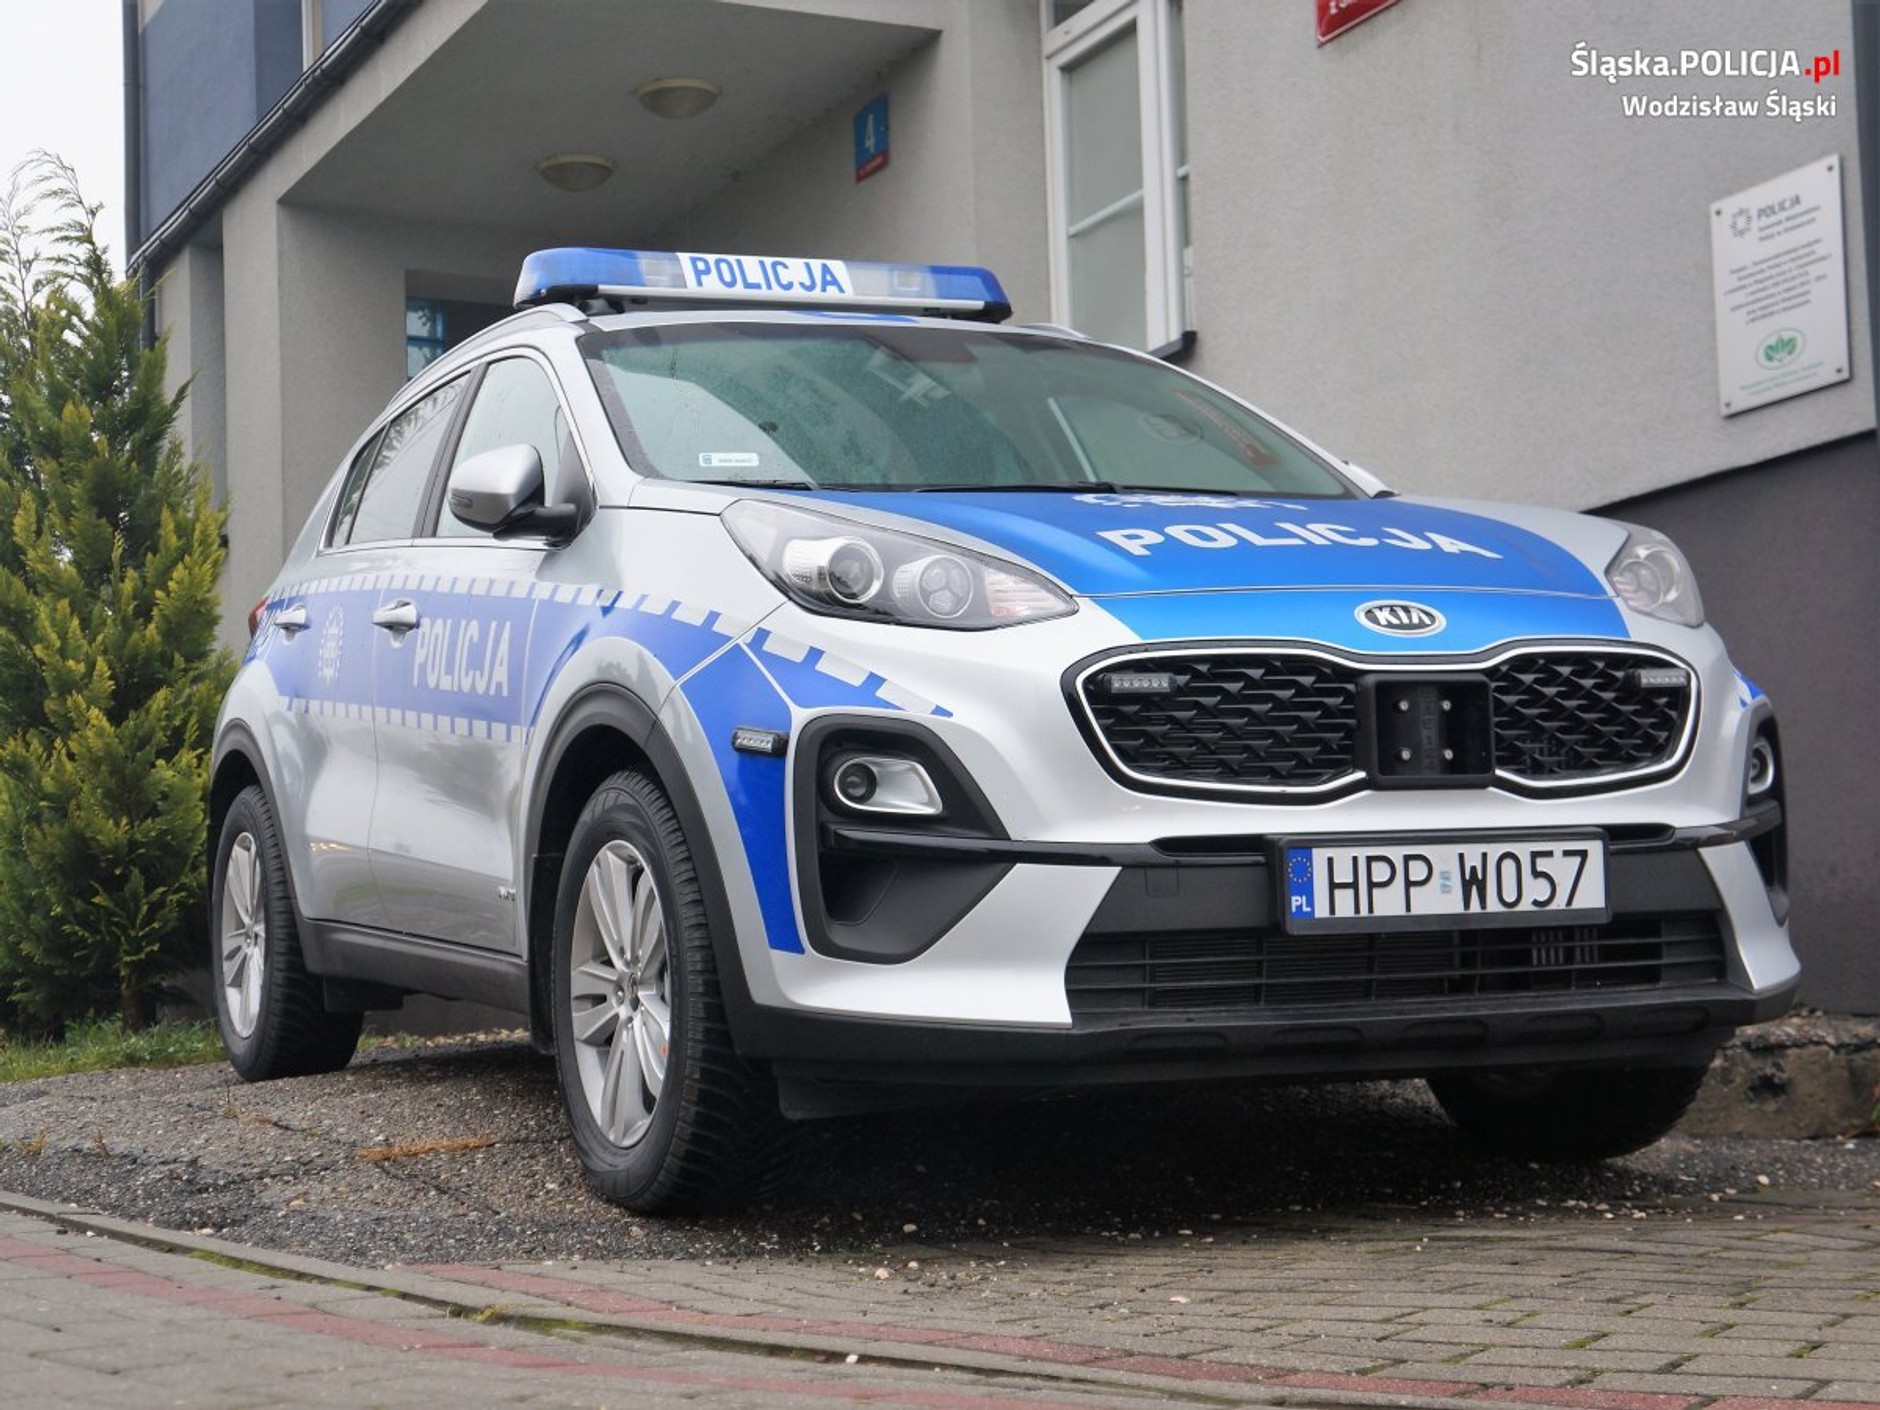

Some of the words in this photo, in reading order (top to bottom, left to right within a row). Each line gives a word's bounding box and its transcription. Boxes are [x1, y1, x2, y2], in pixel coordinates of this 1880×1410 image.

[688, 255, 846, 294] POLICJA
[1096, 521, 1504, 560] POLICJA
[1373, 605, 1436, 627] KIA
[413, 617, 512, 697] POLICJA
[1326, 853, 1434, 916] HPP
[1457, 848, 1589, 911] W057
[1290, 895, 1312, 913] PL
